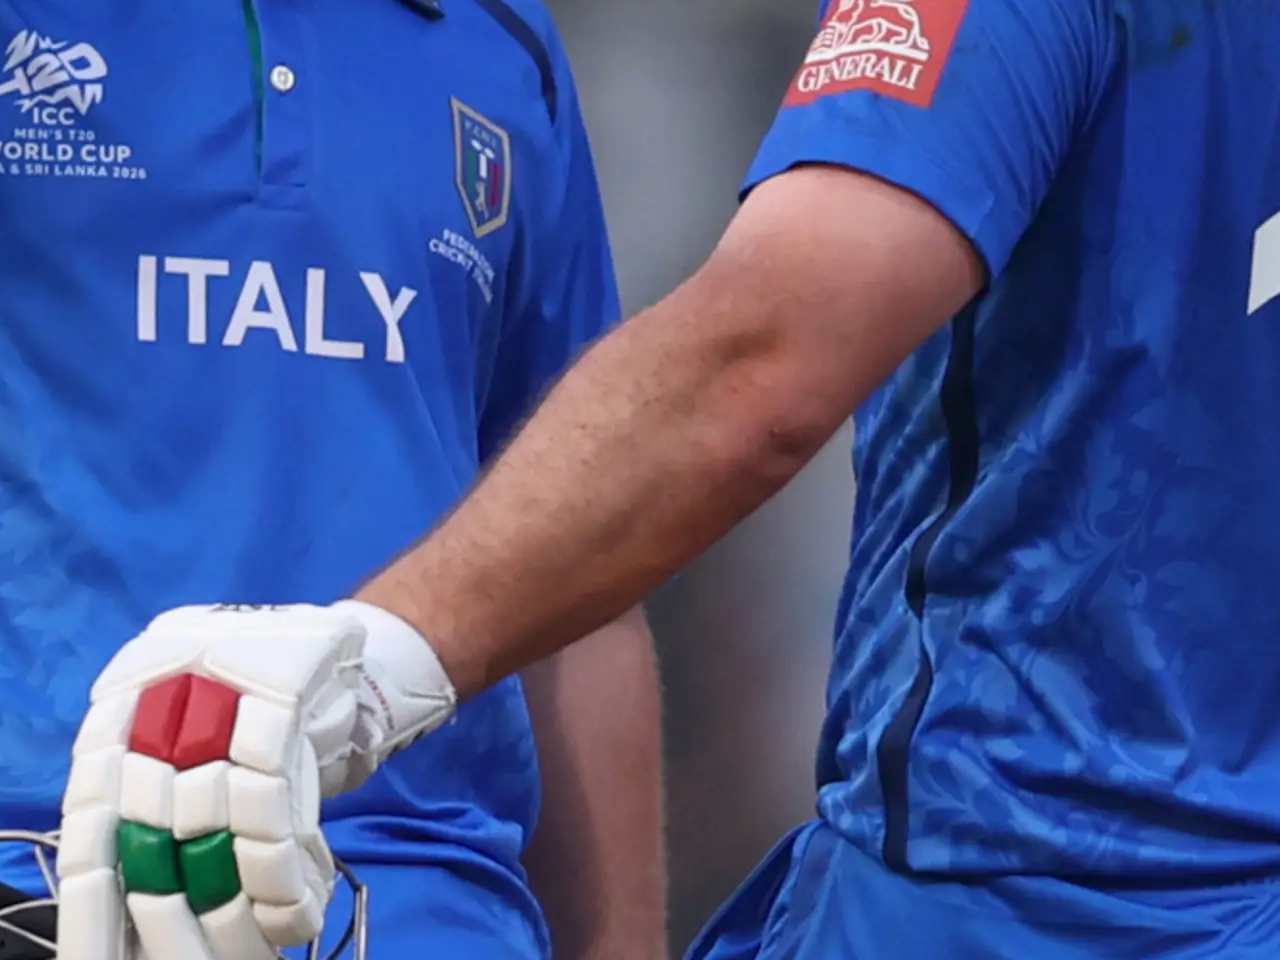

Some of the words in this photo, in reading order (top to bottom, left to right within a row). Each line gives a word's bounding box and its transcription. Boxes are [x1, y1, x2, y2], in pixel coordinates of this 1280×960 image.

[797, 52, 923, 92] GENERALI
[33, 106, 75, 126] ICC
[14, 128, 63, 140] MEN'S
[68, 129, 96, 141] T20
[80, 144, 132, 164] CUP
[24, 163, 50, 176] SRI
[54, 165, 108, 178] LANKA
[112, 166, 148, 180] 2026
[137, 254, 419, 363] ITALY
